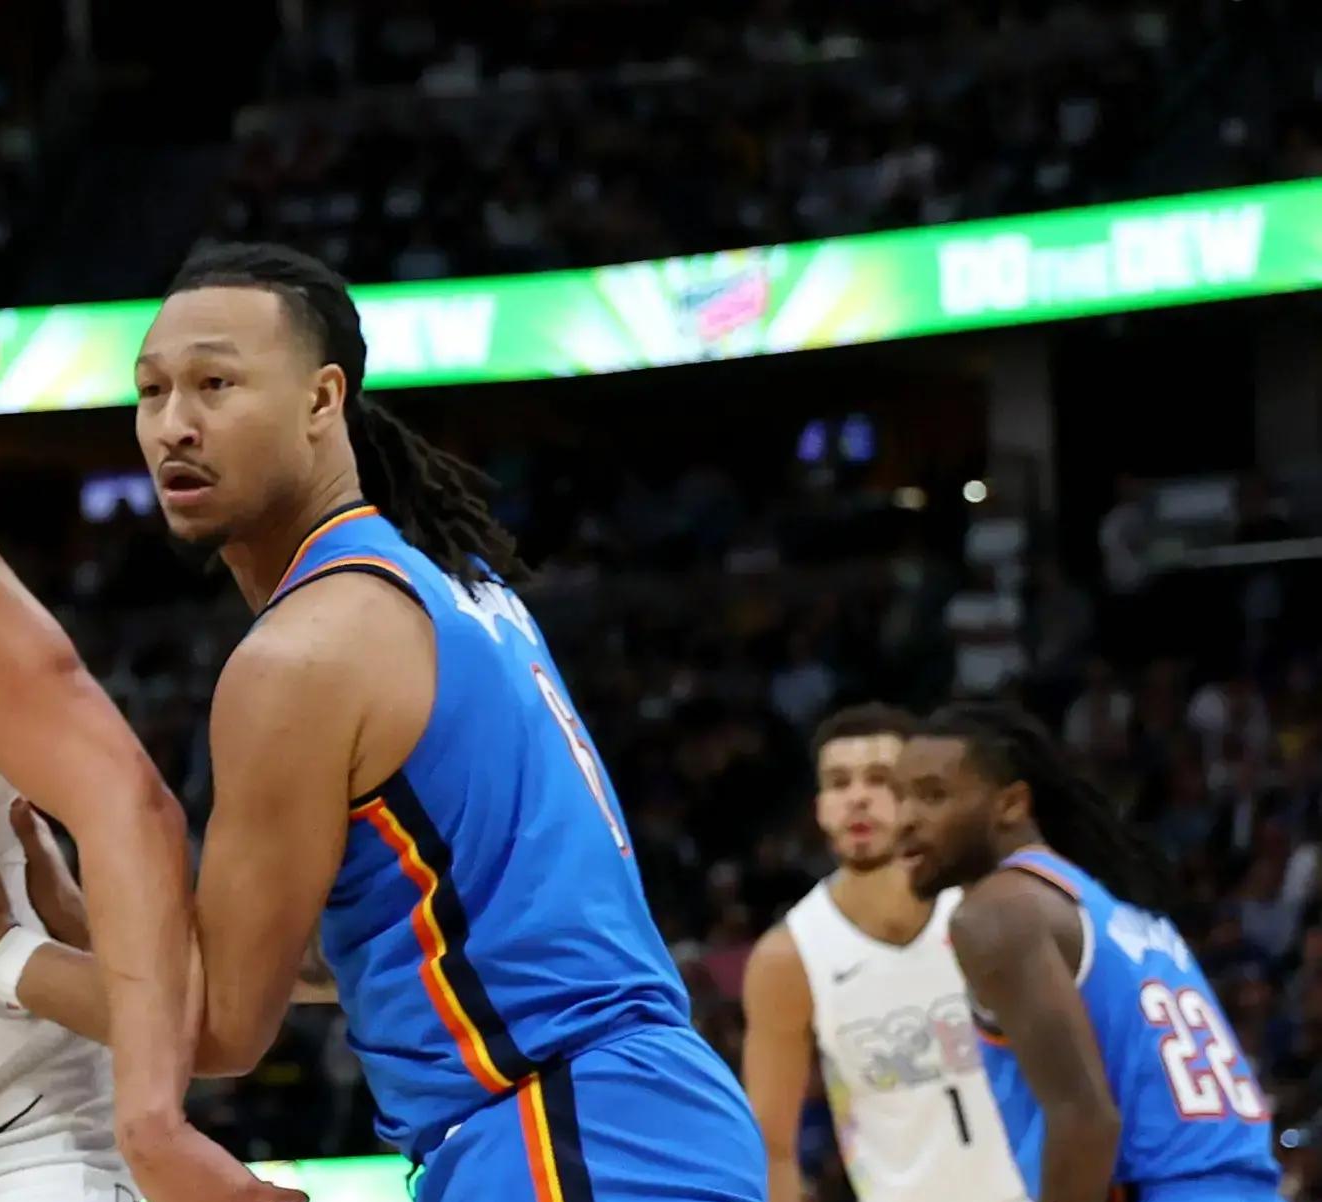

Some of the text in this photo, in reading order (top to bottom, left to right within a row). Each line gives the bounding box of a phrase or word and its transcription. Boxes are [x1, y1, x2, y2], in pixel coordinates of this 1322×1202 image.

[940, 236, 1031, 314] DO
[1112, 204, 1265, 294] DEW
[1138, 979, 1273, 1123] 22
[944, 1086, 971, 1147] 1
